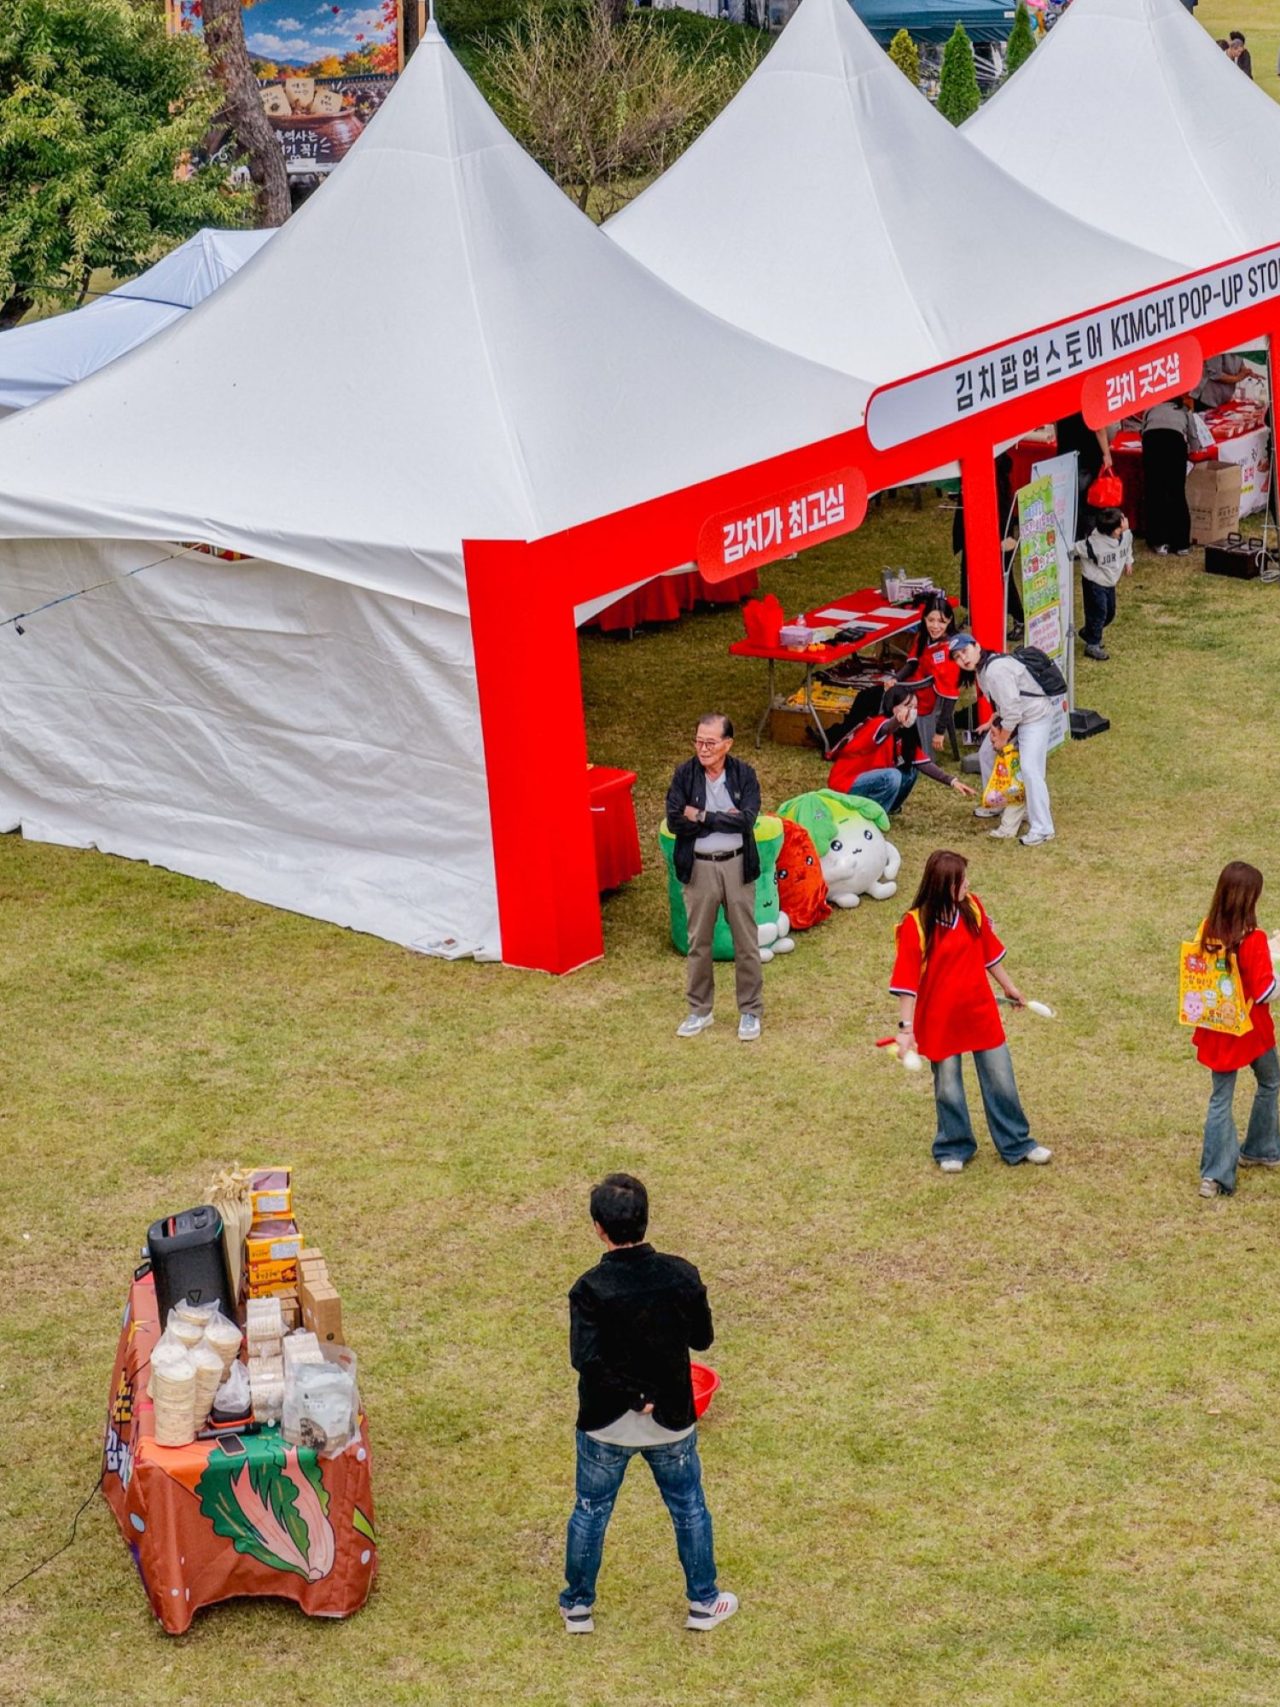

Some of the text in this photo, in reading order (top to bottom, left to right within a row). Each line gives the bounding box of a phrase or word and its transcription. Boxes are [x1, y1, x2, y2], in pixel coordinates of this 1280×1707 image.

[300, 143, 318, 157] 꼭!
[955, 322, 1103, 412] 김치팝업스토어
[1110, 297, 1176, 351] KIMCHI
[1179, 274, 1244, 325] POP-UP
[1106, 351, 1181, 412] 김치 굿즈샵
[723, 484, 845, 564] 김치가 최고심
